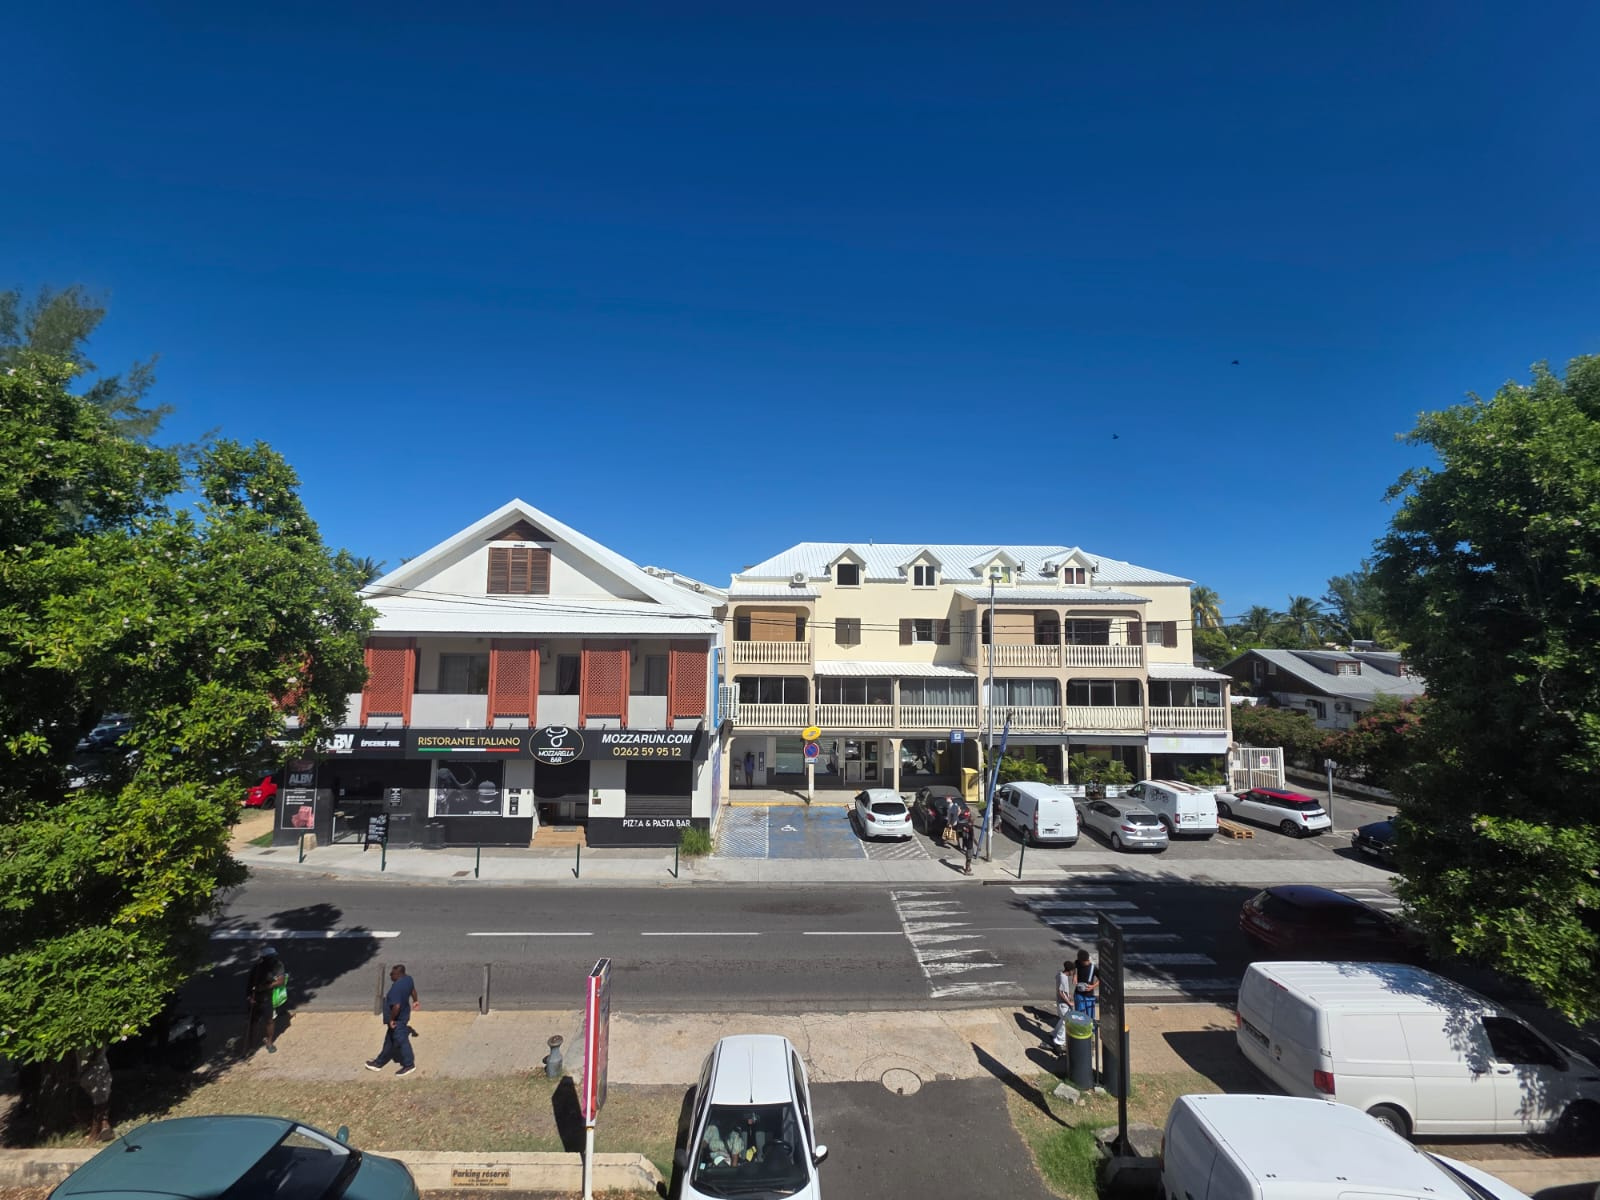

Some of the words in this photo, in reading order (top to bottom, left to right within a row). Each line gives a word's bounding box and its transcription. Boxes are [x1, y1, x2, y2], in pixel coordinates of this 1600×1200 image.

[418, 737, 475, 745] RISTORANTE
[477, 737, 520, 745] ITALIANO
[601, 734, 693, 744] MOZZARUN.COM
[612, 747, 639, 756] 0262
[641, 747, 654, 756] 59
[656, 747, 669, 756] 95
[671, 747, 681, 756] 12
[622, 819, 644, 827] PIZZA
[652, 819, 675, 827] PASTA
[676, 819, 691, 827] BAR
[452, 1169, 481, 1179] Parking
